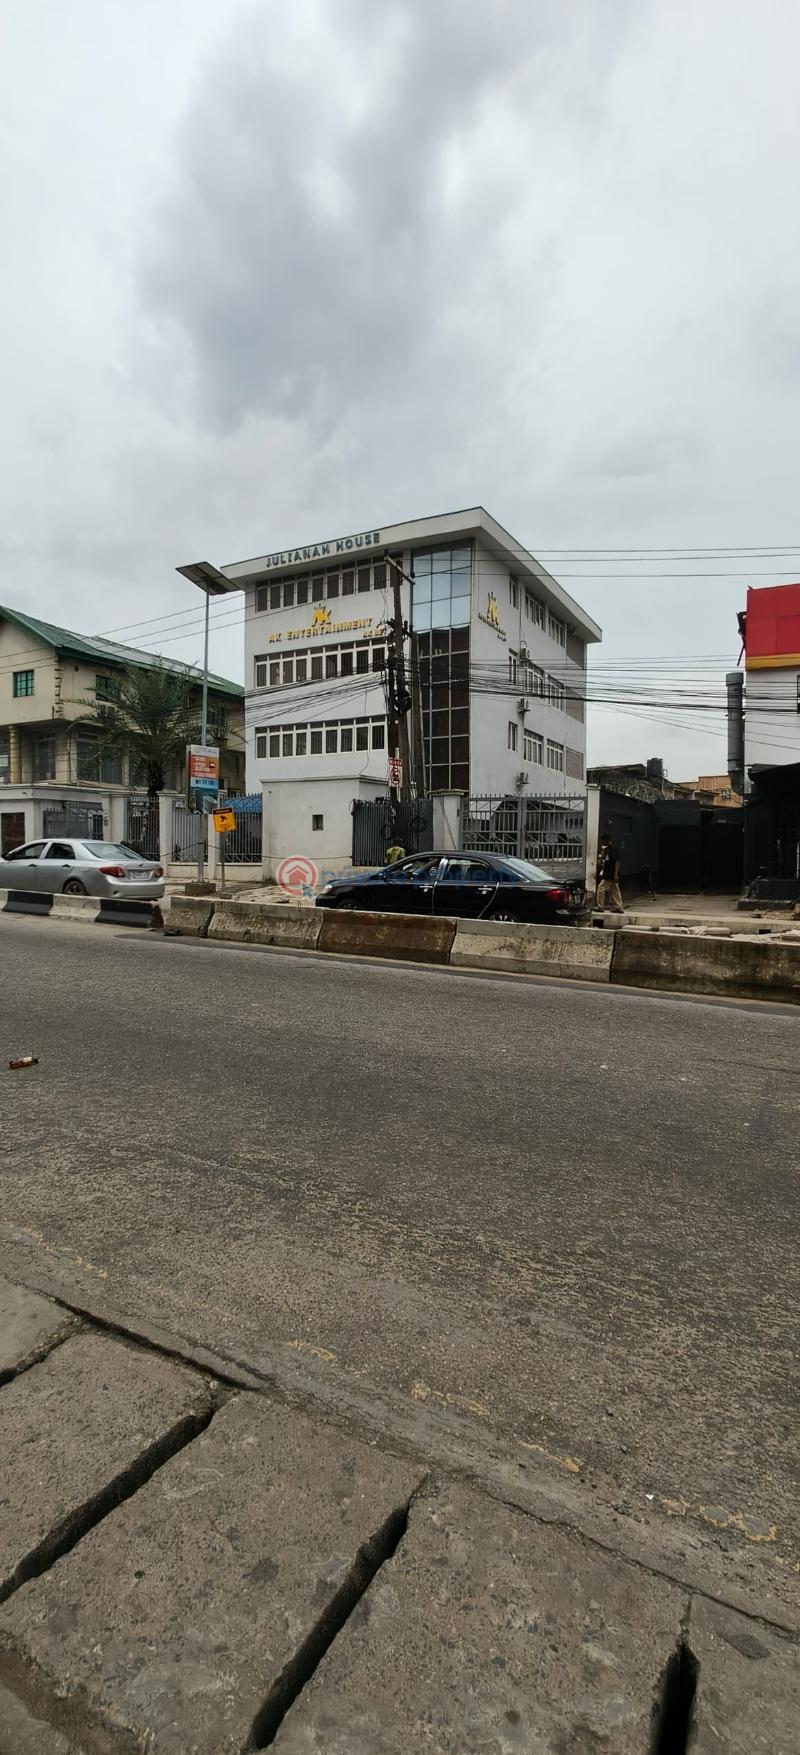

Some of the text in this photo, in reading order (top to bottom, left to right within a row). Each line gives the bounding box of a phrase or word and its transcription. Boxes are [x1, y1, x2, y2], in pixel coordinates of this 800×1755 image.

[266, 533, 381, 568] JULIANAH HOUSE
[268, 618, 373, 644] AK ENTERTAINMENT
